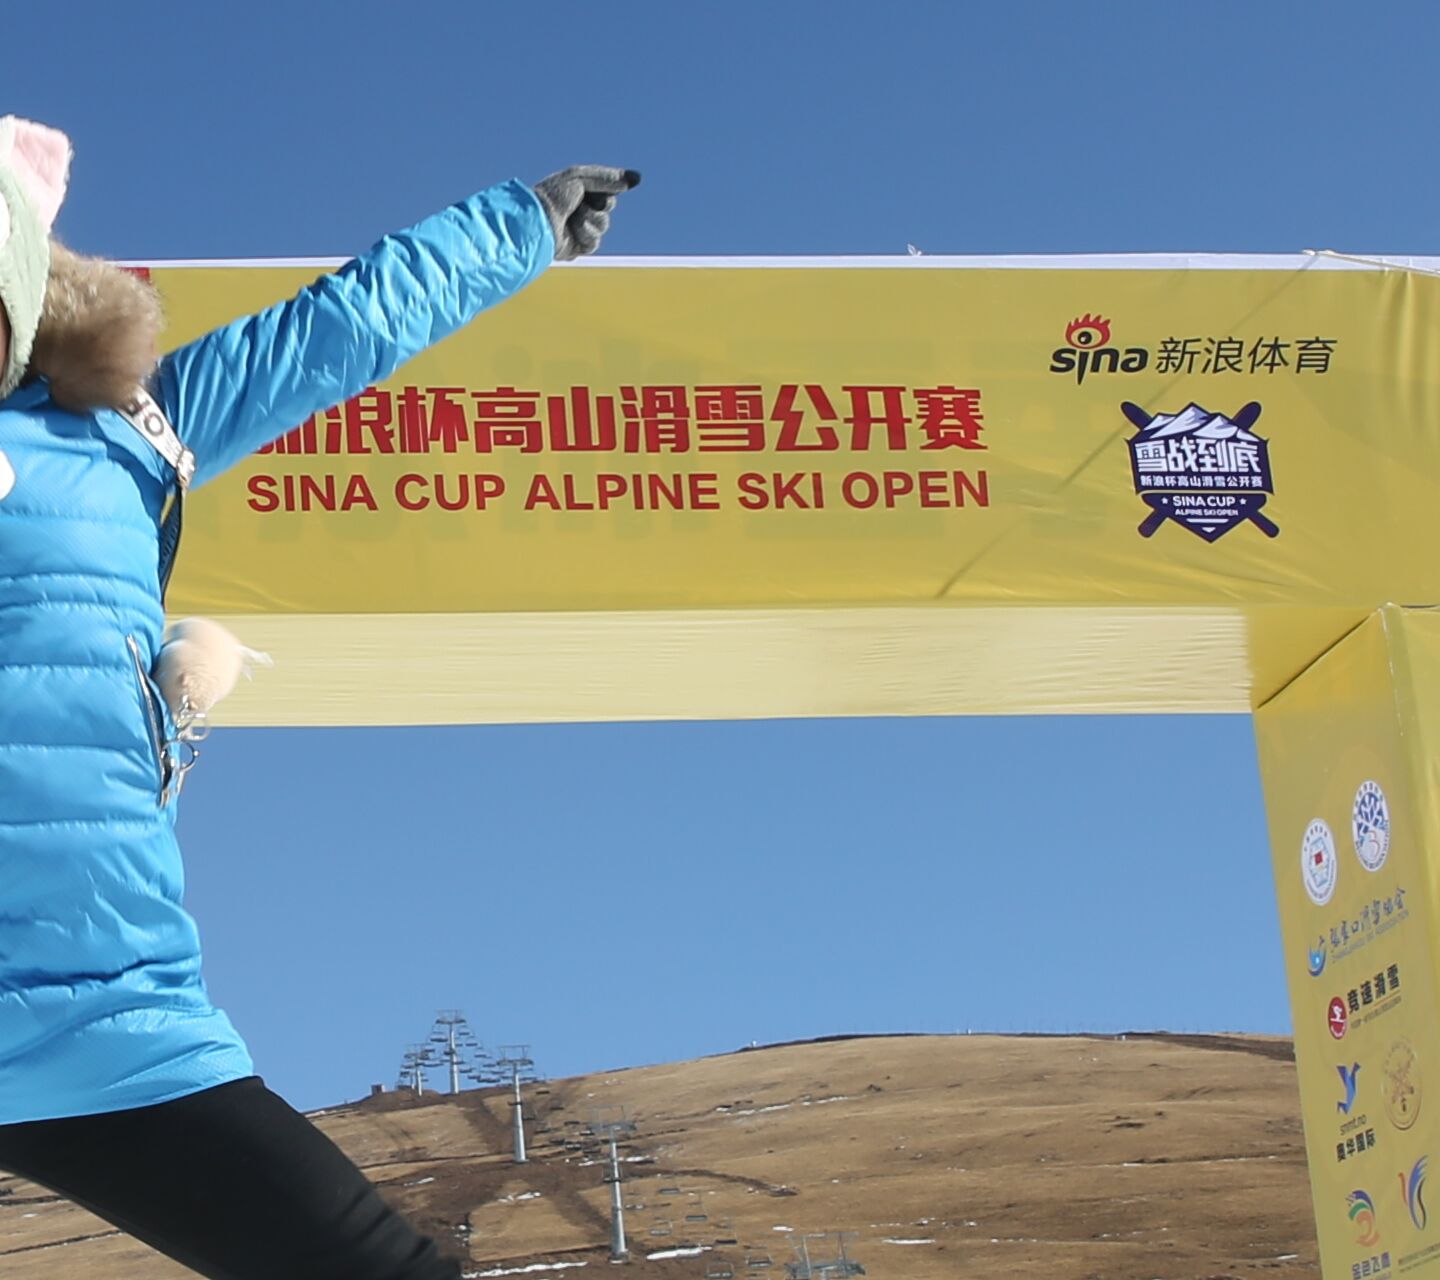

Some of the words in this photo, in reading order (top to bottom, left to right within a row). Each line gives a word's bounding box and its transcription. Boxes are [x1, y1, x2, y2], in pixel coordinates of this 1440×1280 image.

[1049, 347, 1149, 385] sina
[1154, 336, 1338, 375] 新浪体育
[254, 385, 989, 455] 浪杯高山滑雪公开赛
[1134, 436, 1262, 473] 雪战到底
[246, 474, 378, 512] SINA
[394, 473, 506, 512] CUP
[523, 473, 720, 511] ALPINE
[737, 471, 825, 510] SKI
[841, 470, 990, 509] OPEN
[1140, 475, 1263, 488] 新浪杯高山滑雪公开赛
[1172, 495, 1206, 507] SINA
[1207, 495, 1236, 507] CUP
[1347, 963, 1400, 1013] 竞速滑雪
